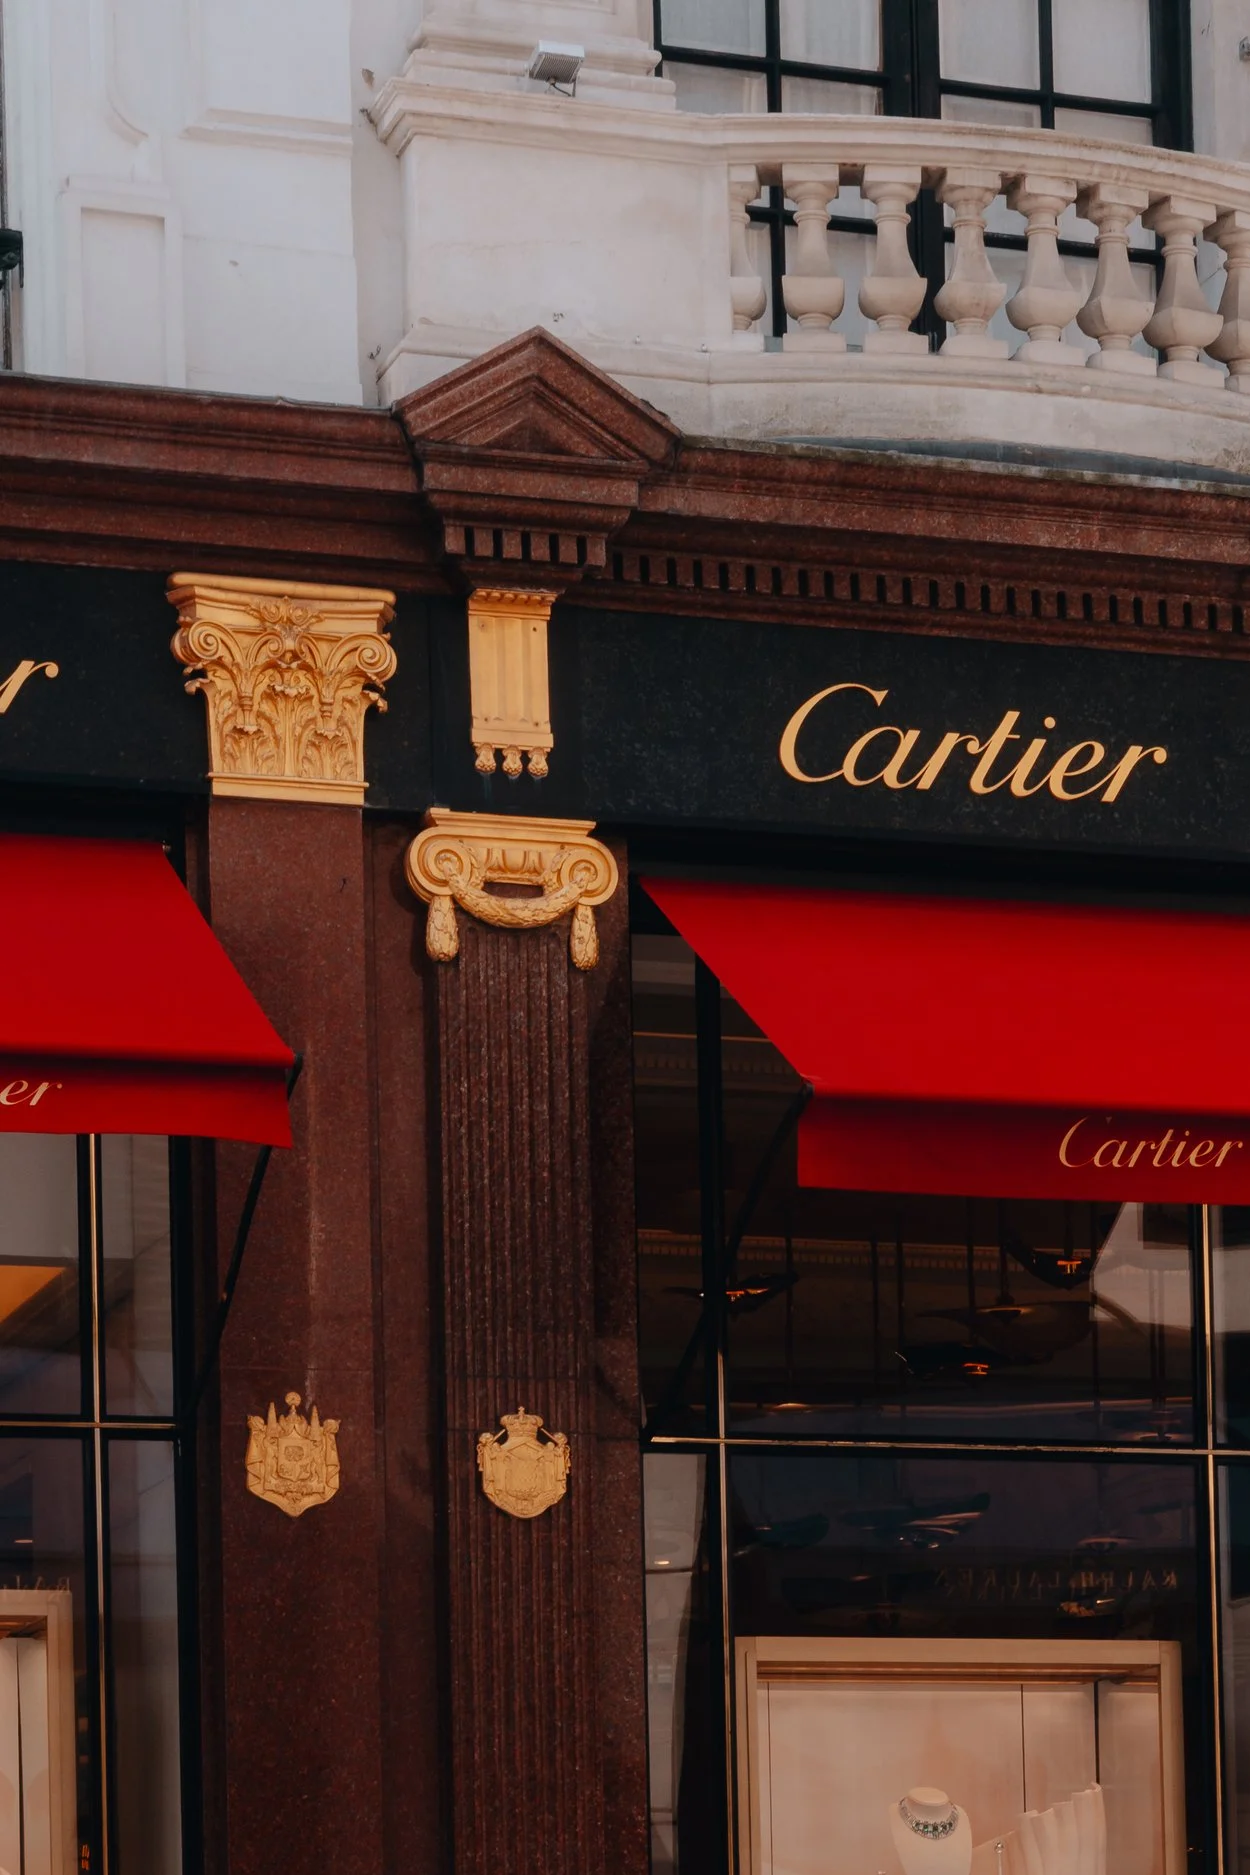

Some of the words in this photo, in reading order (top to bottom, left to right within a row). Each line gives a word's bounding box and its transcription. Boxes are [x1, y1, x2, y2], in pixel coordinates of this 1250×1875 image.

[778, 683, 1168, 803] Cartier
[0, 1080, 63, 1106] er
[1058, 1115, 1244, 1168] Cartier
